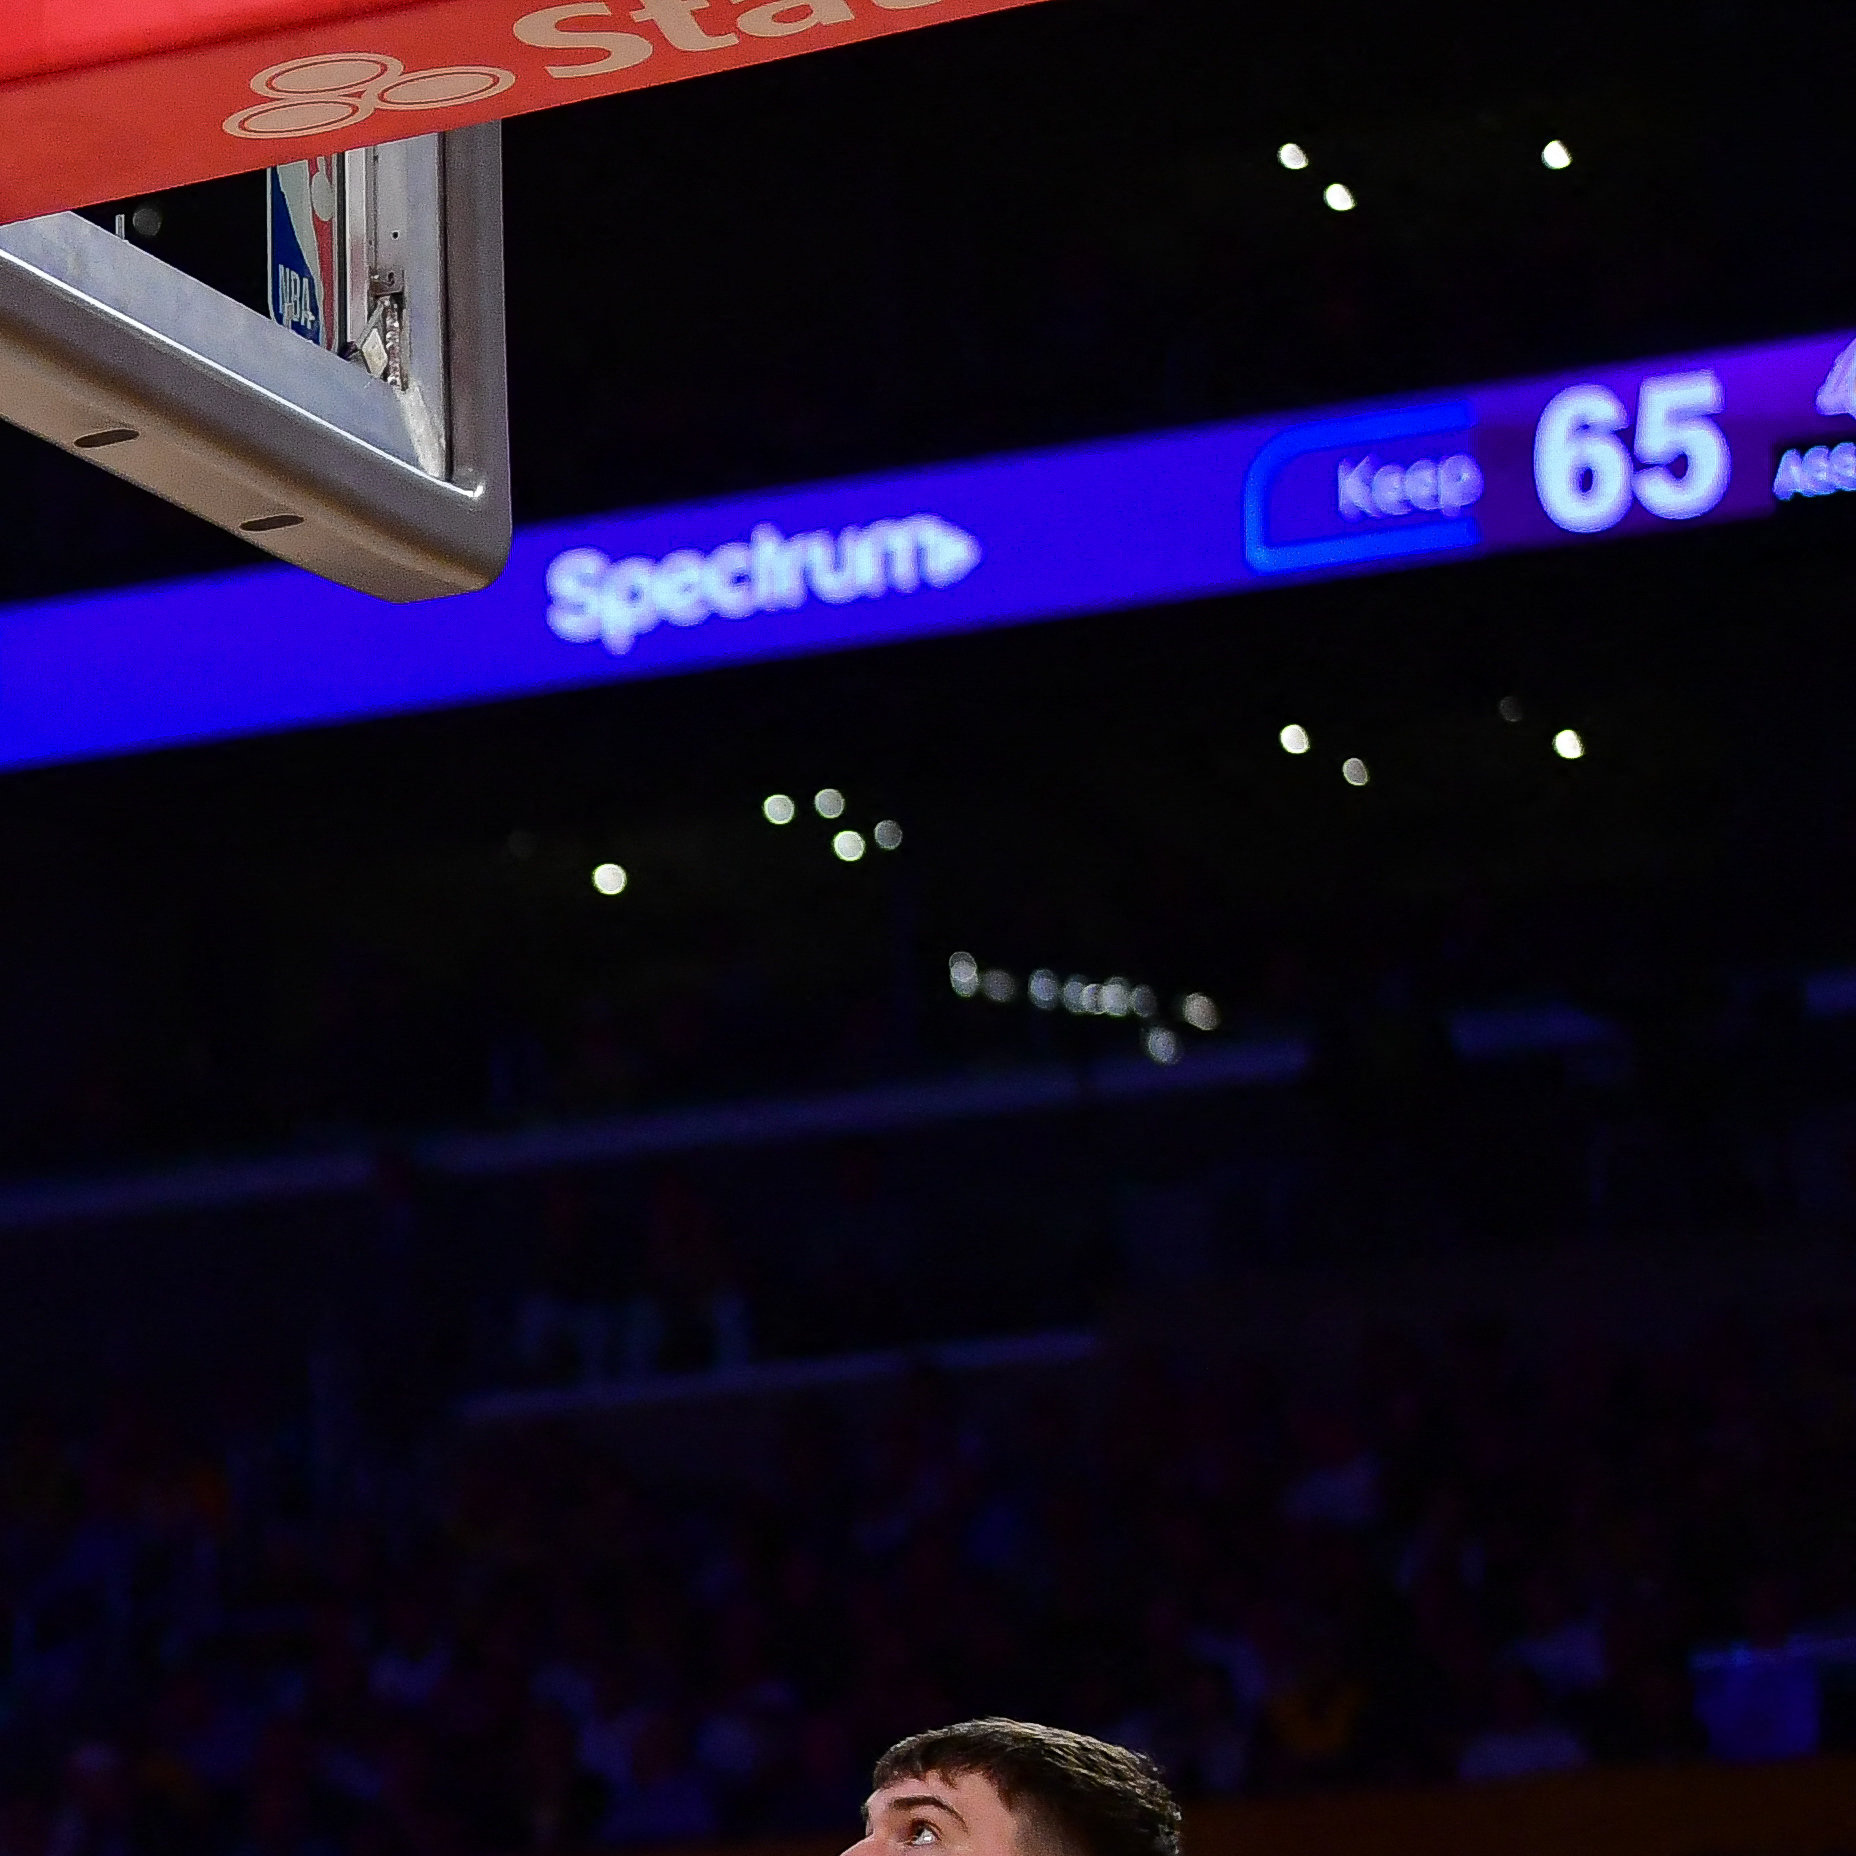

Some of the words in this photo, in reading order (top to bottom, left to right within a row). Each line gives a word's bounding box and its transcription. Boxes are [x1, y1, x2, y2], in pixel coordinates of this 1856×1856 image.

[513, 0, 942, 79] Sta
[1338, 453, 1484, 521] Keep
[1533, 369, 1732, 533] 65
[546, 514, 960, 654] Spectrum
